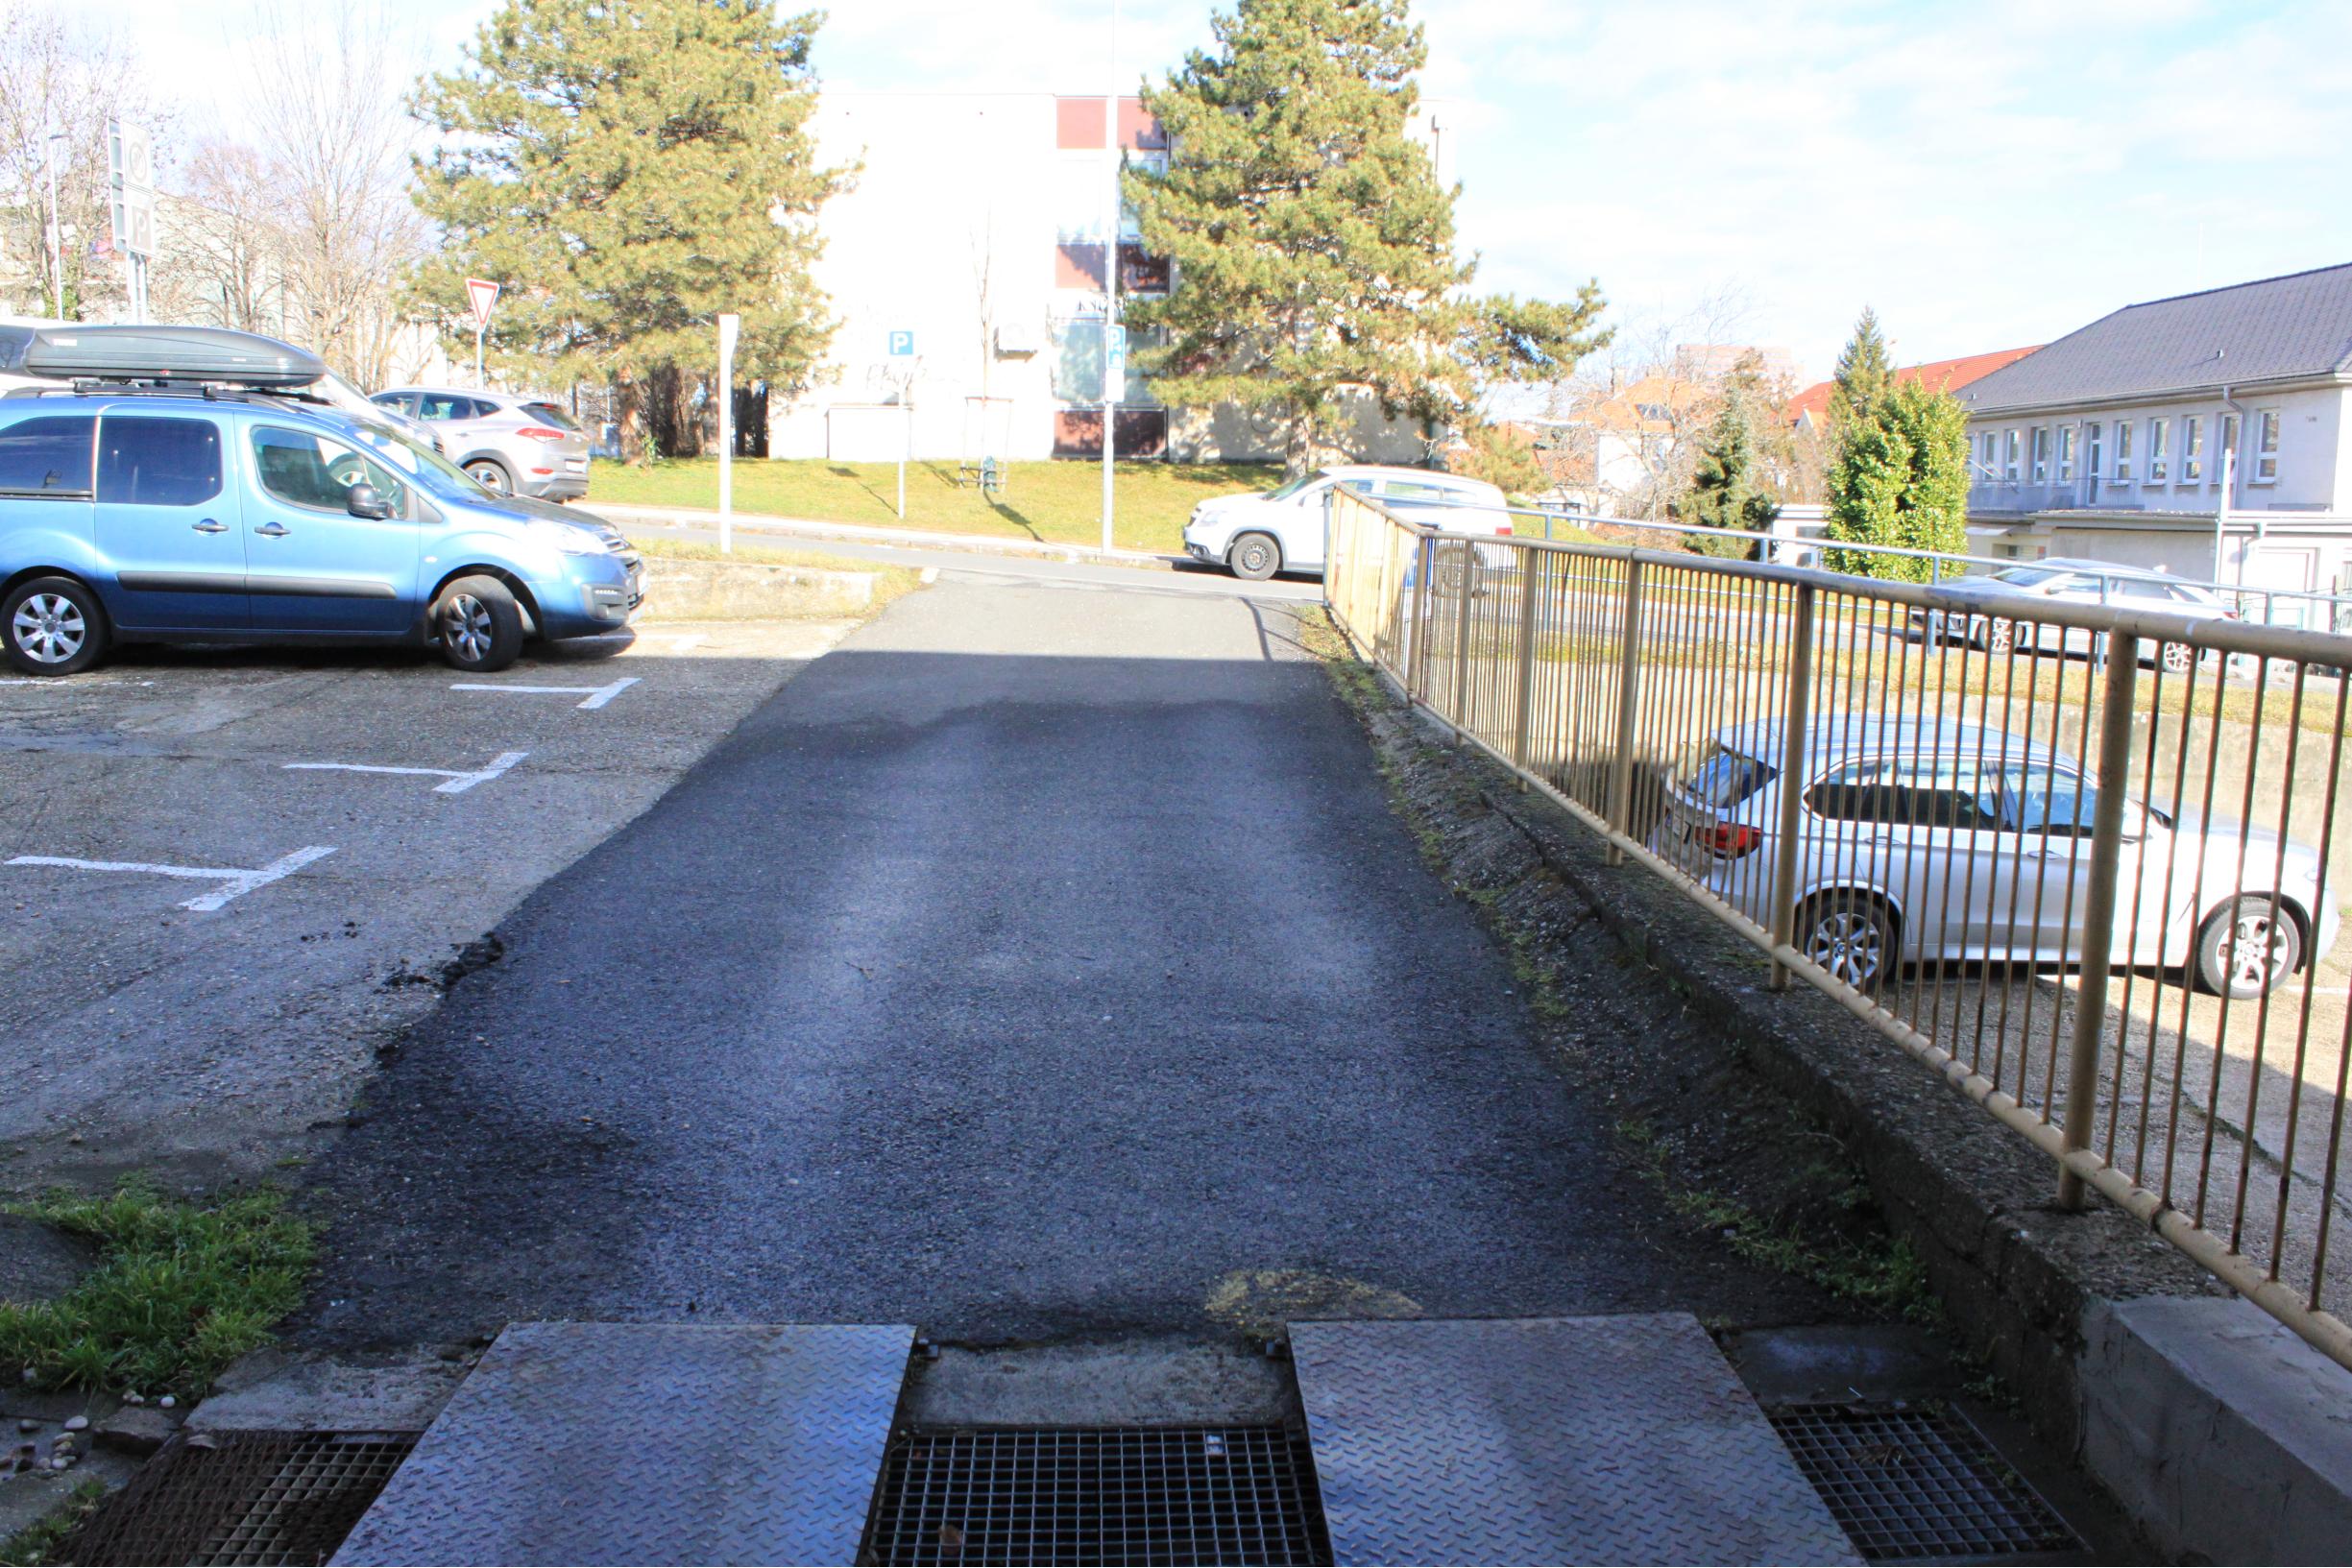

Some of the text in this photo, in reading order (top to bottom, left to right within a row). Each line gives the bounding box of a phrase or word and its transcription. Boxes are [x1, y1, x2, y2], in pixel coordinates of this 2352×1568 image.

[136, 211, 147, 244] P
[893, 332, 909, 354] P
[1109, 328, 1121, 351] P
